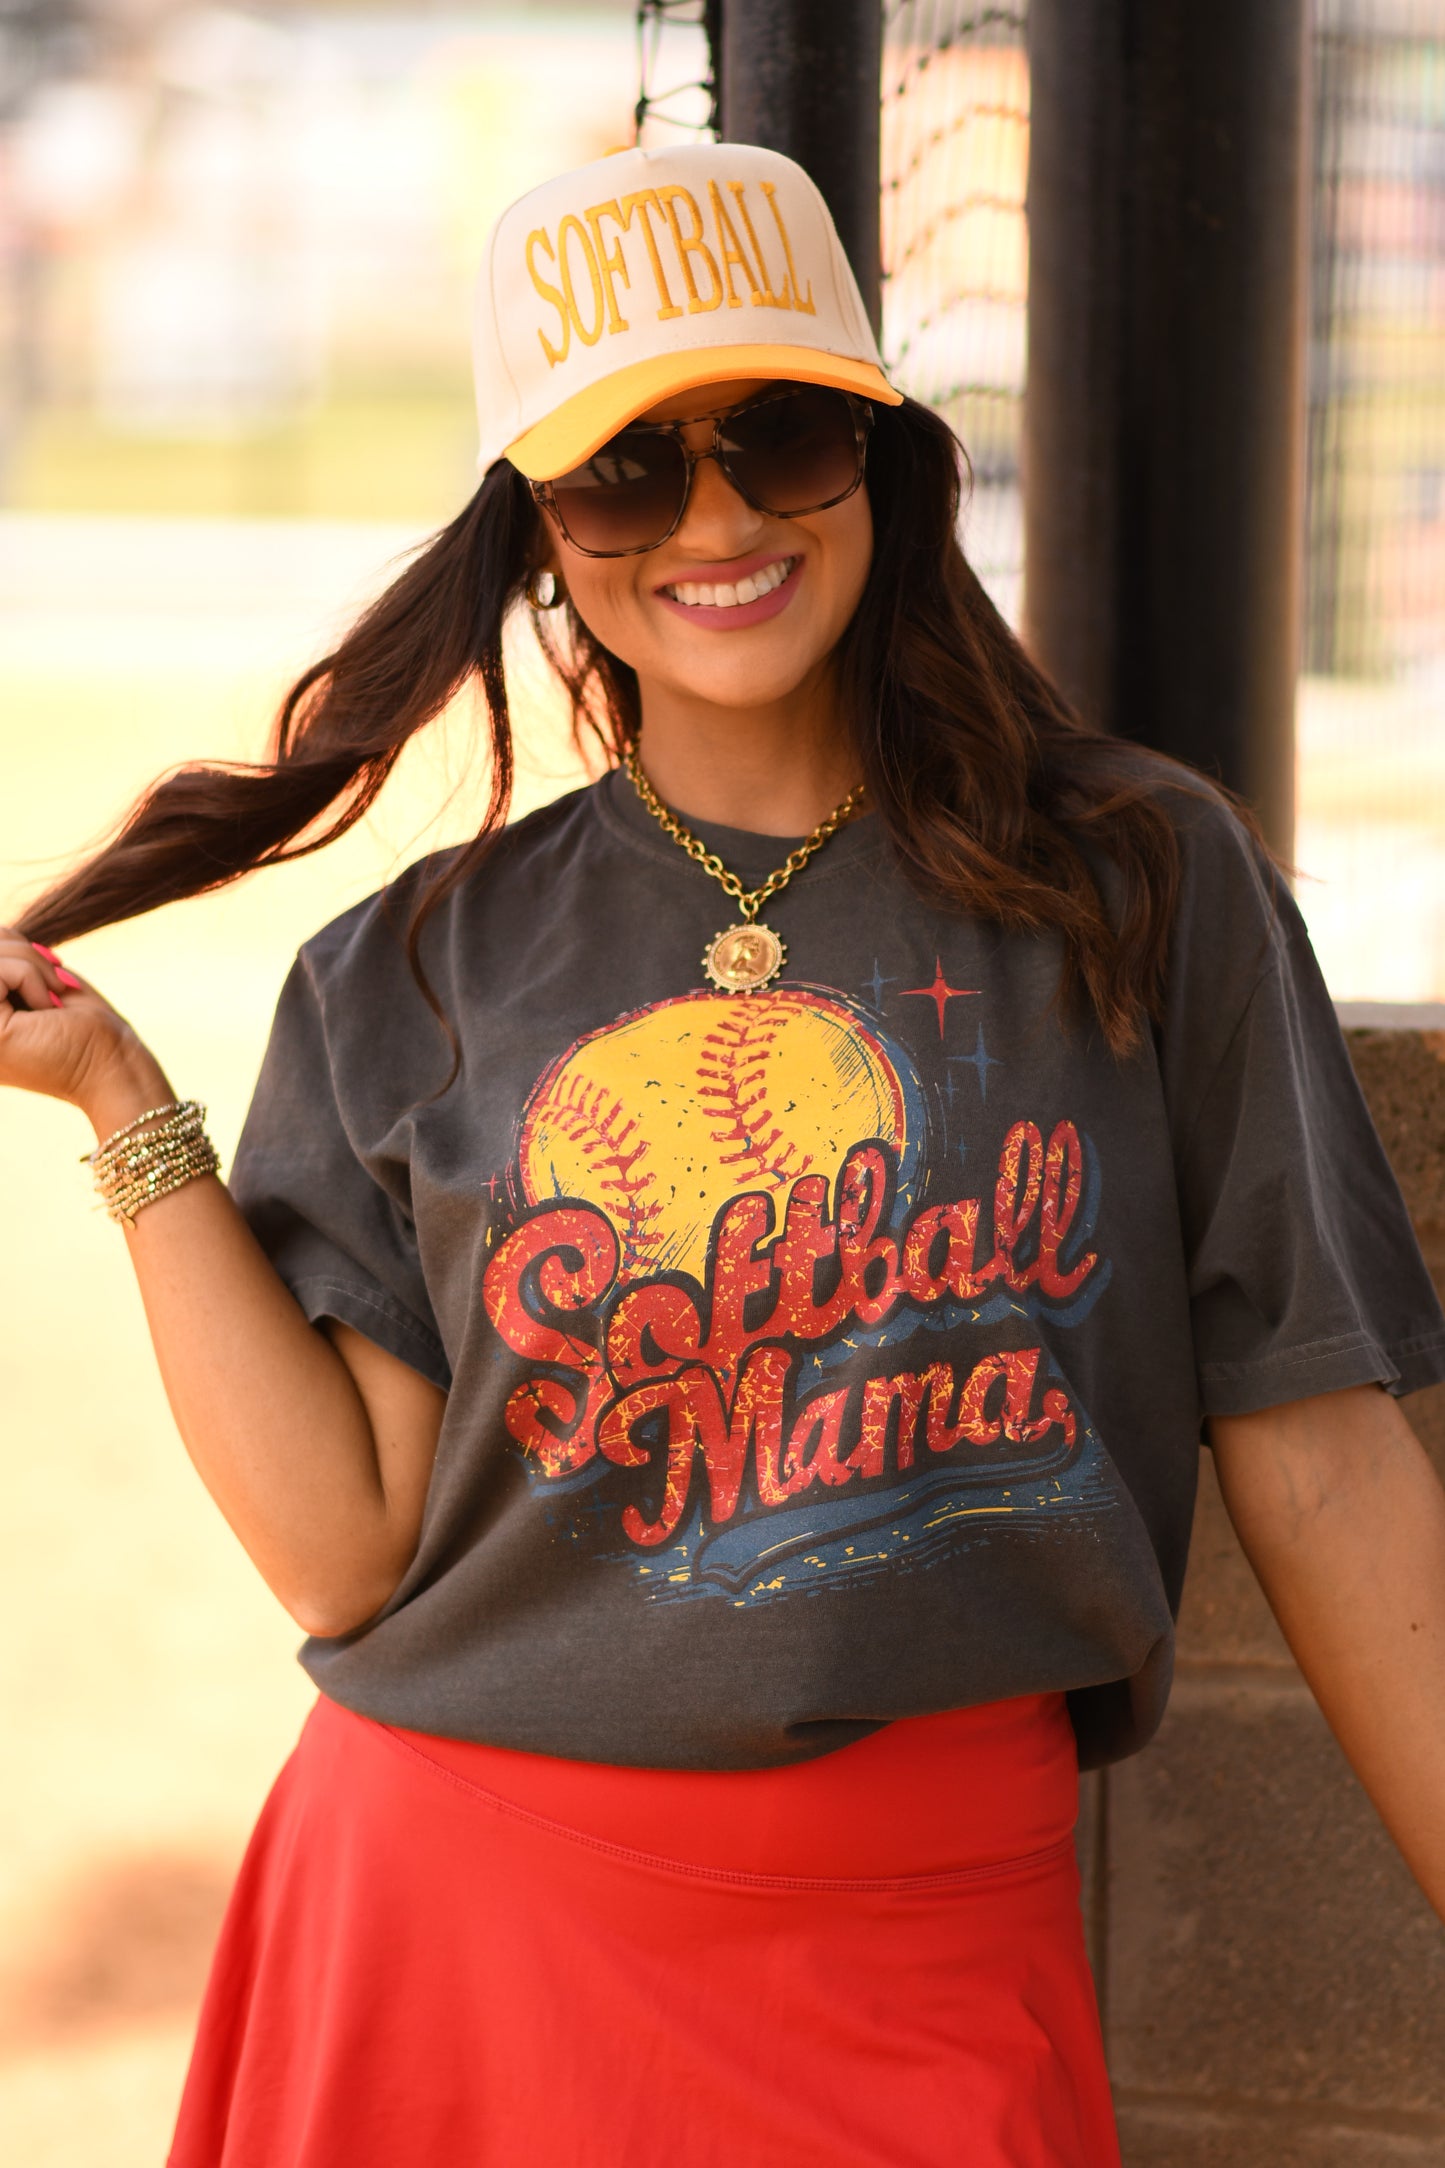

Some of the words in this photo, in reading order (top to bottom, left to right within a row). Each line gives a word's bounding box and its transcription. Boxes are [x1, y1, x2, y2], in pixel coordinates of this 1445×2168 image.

[525, 179, 816, 368] SOFTBALL
[483, 1120, 1098, 1478] Softball
[598, 1346, 1077, 1546] Mama
